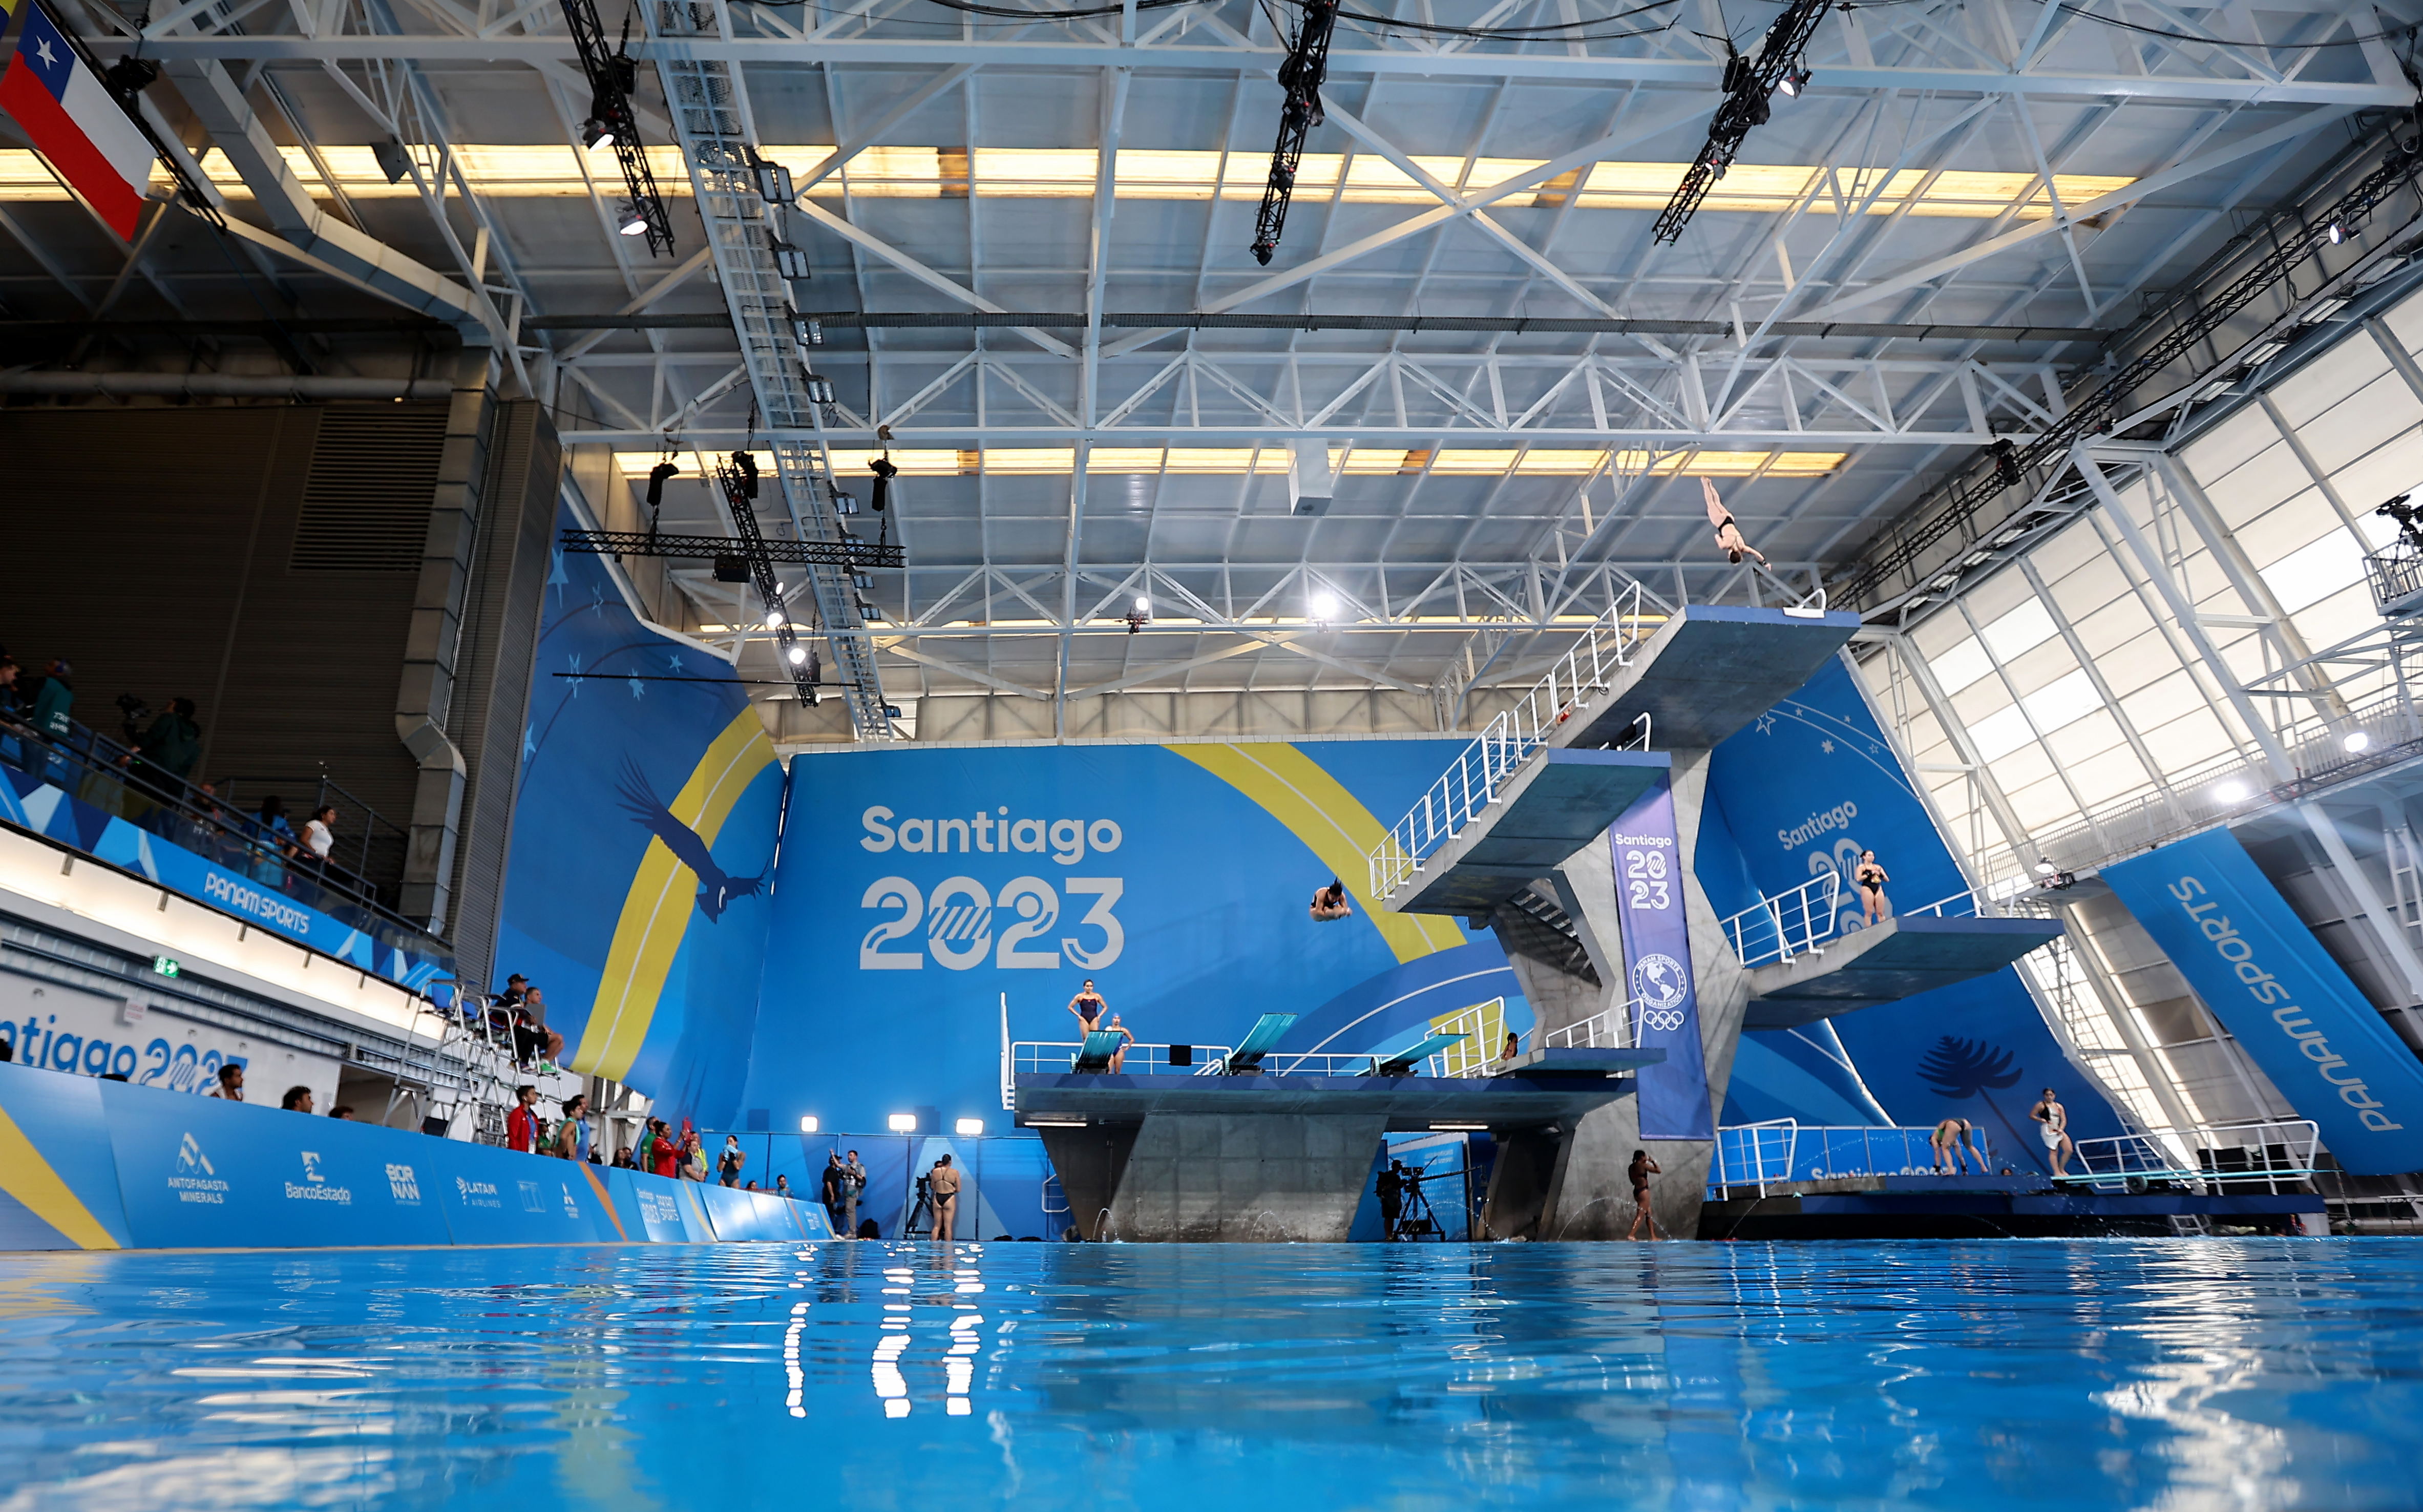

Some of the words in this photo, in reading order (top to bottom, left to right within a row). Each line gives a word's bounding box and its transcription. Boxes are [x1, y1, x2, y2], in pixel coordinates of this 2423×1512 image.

[860, 805, 1123, 865] Santiago
[1778, 801, 1858, 851] Santiago
[1615, 833, 1673, 849] Santiago
[1626, 849, 1668, 879] 20
[204, 872, 262, 914] PANAM
[260, 897, 310, 934] SPORTS
[1630, 880, 1671, 910] 23
[859, 876, 1124, 971] 2023
[2167, 875, 2291, 1004] SPORTS
[1637, 956, 1656, 971] PANAM
[1657, 956, 1681, 972] SPORTS
[1641, 992, 1682, 1008] ORGANIZATION
[2272, 1005, 2404, 1131] PANAM
[385, 1163, 414, 1182] BOR
[168, 1177, 229, 1192] ANTOFAGASTA
[284, 1181, 351, 1202] BancoEstado
[390, 1182, 420, 1201] NAN
[466, 1182, 497, 1195] LATAM
[179, 1191, 224, 1204] MINERALS
[471, 1198, 501, 1208] AIRLINES
